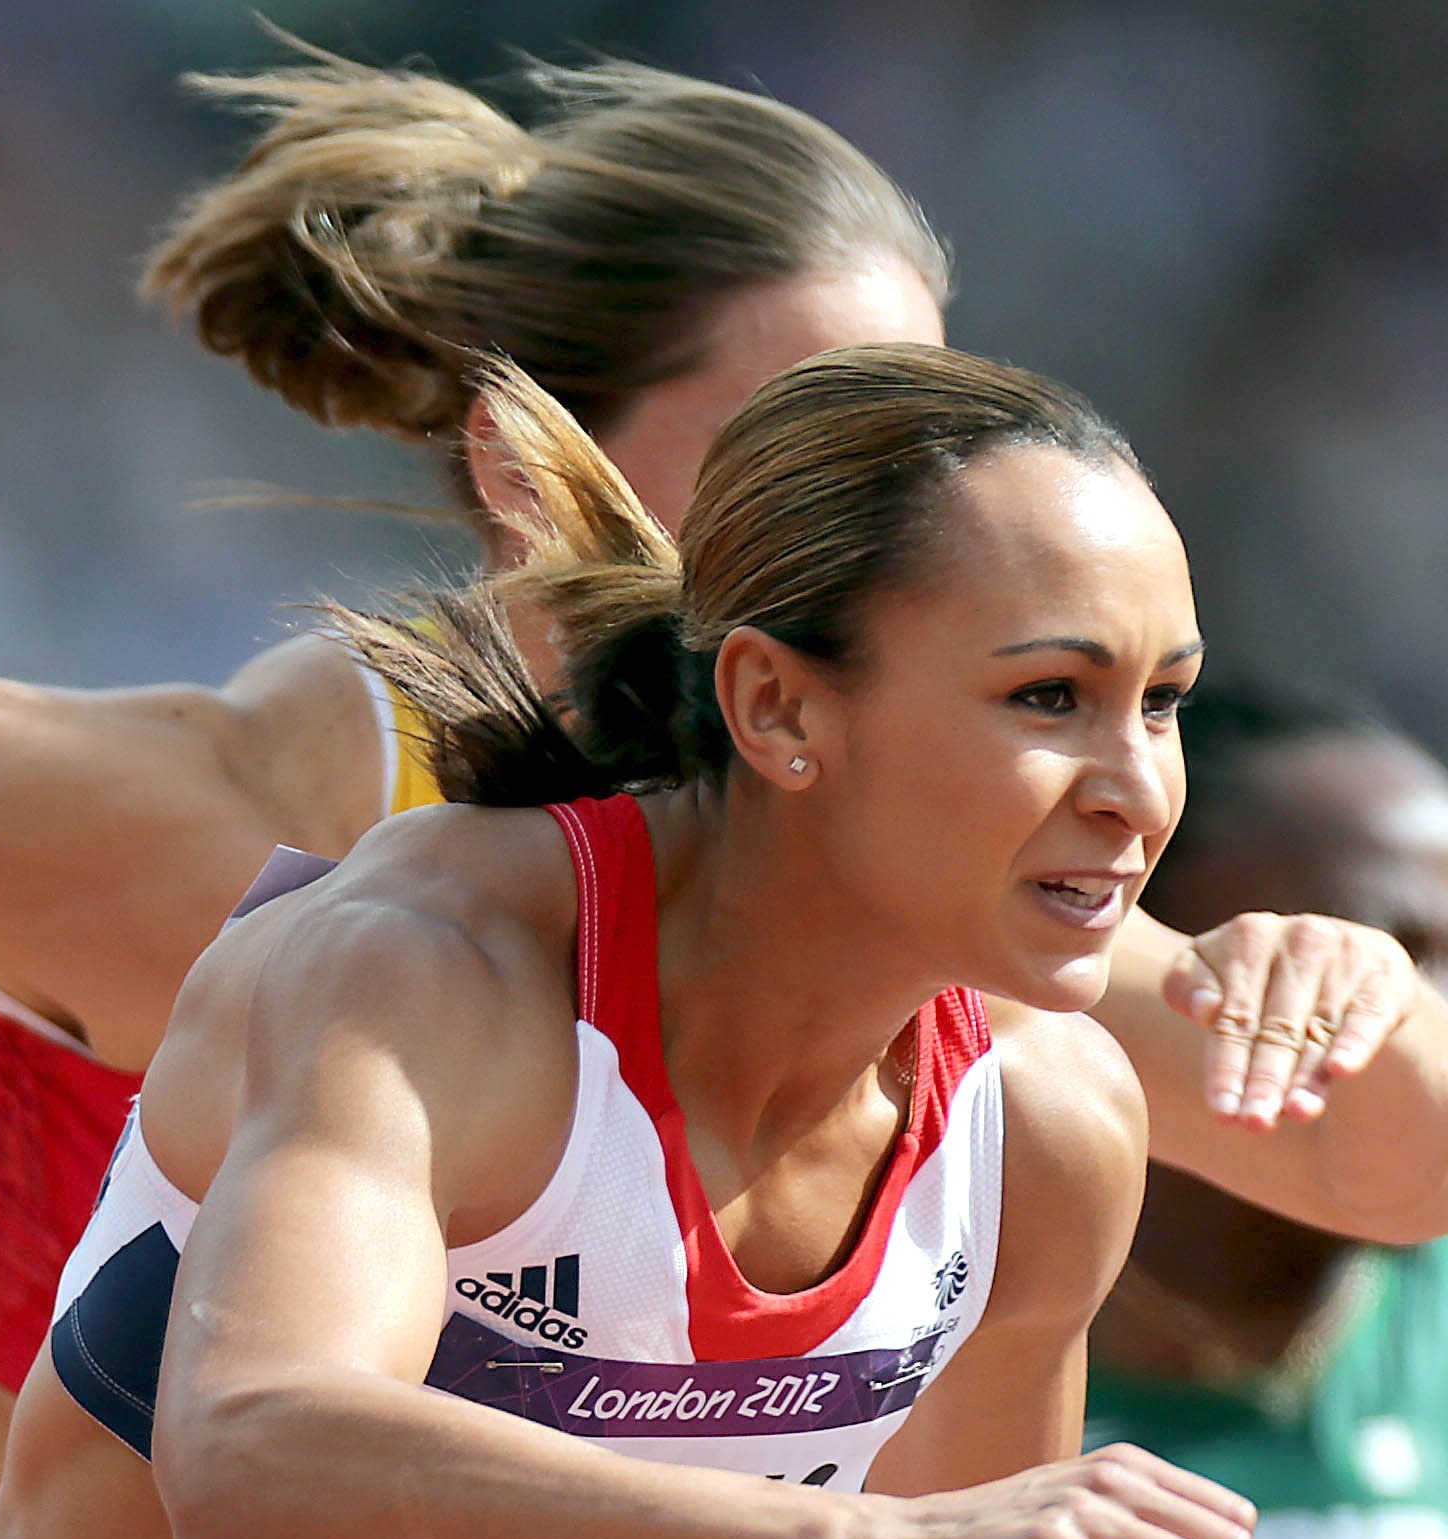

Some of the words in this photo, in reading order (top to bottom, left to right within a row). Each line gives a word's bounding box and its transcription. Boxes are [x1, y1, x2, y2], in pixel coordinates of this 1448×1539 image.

[455, 1278, 588, 1349] adidas
[567, 1375, 737, 1420] London
[737, 1370, 841, 1418] 2012
